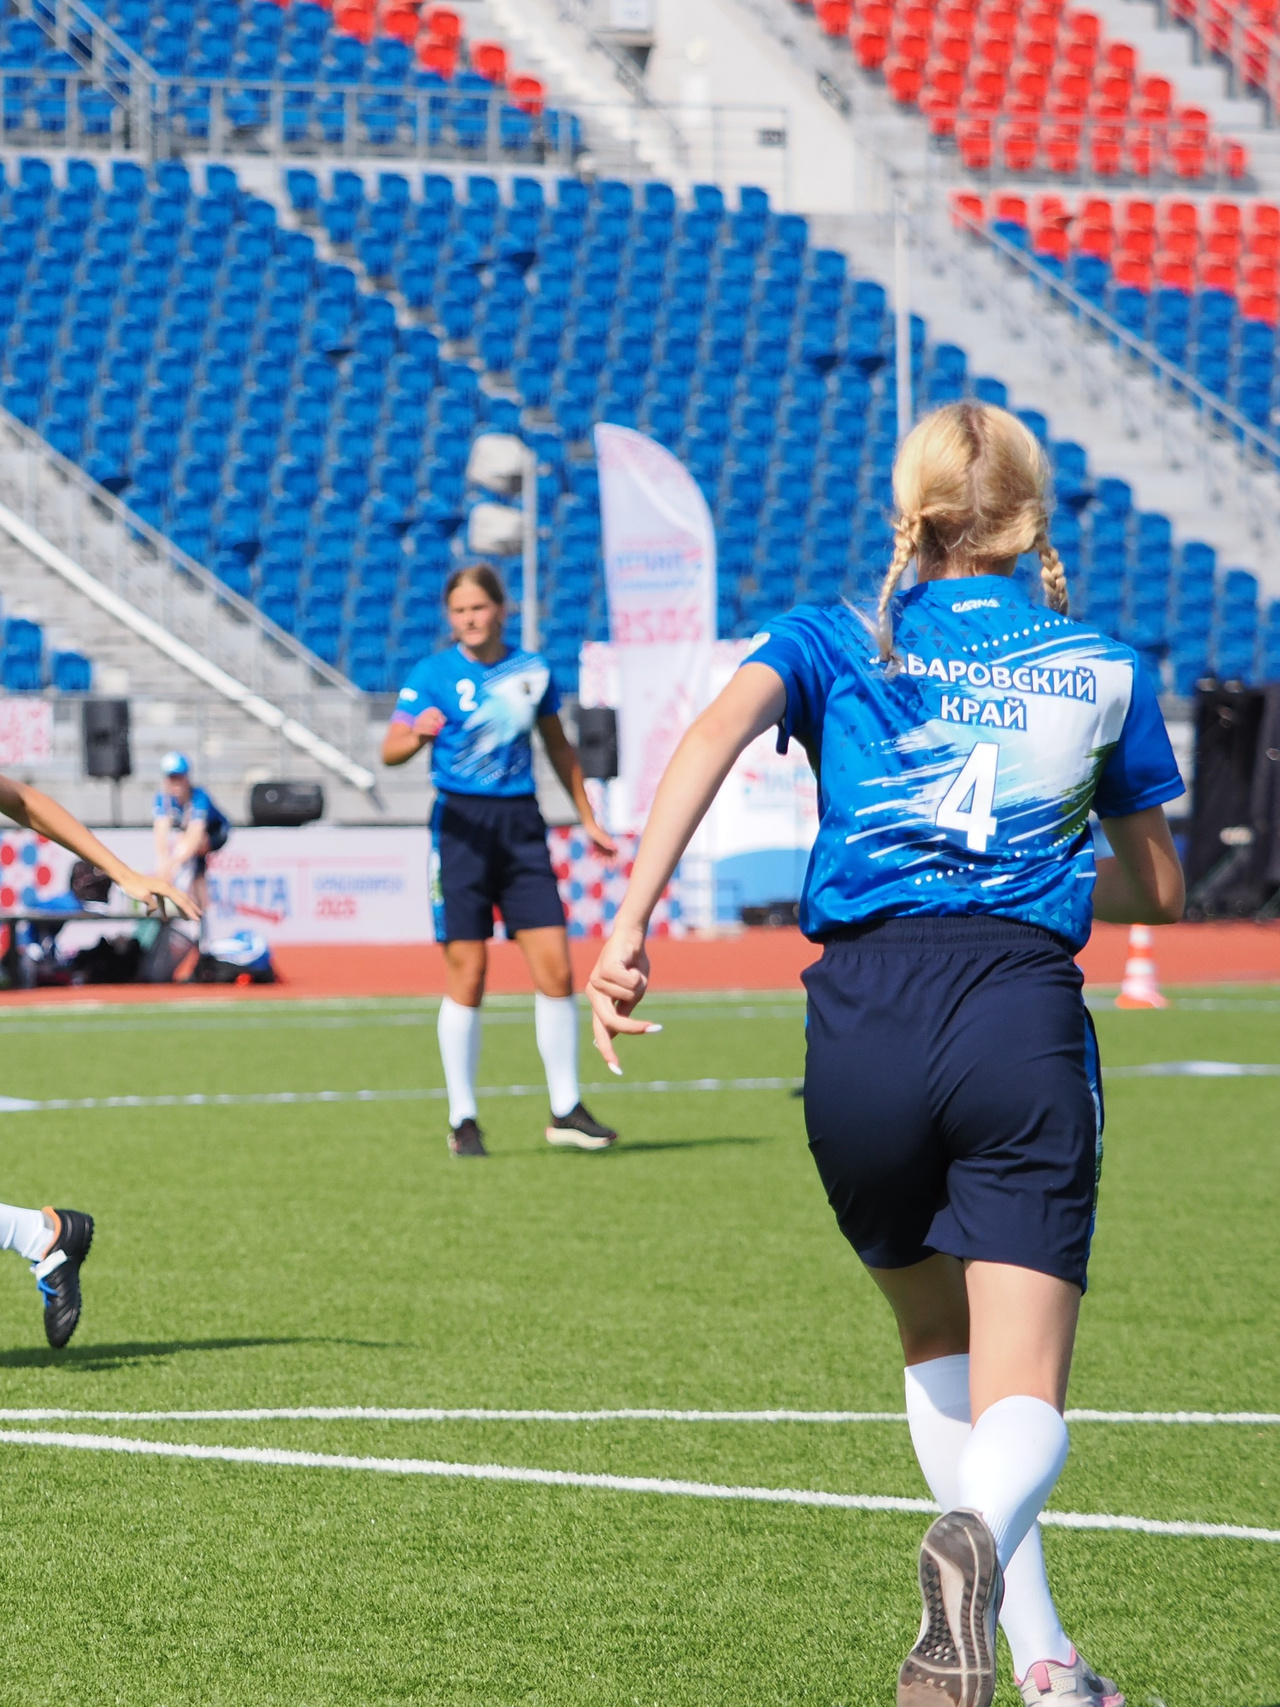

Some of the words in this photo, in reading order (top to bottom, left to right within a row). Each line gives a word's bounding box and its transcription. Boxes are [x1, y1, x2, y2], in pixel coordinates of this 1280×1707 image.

[456, 678, 478, 712] 2
[869, 653, 1095, 701] АБАРОВСКИЙ
[941, 695, 1024, 729] КРАЙ
[935, 741, 999, 853] 4
